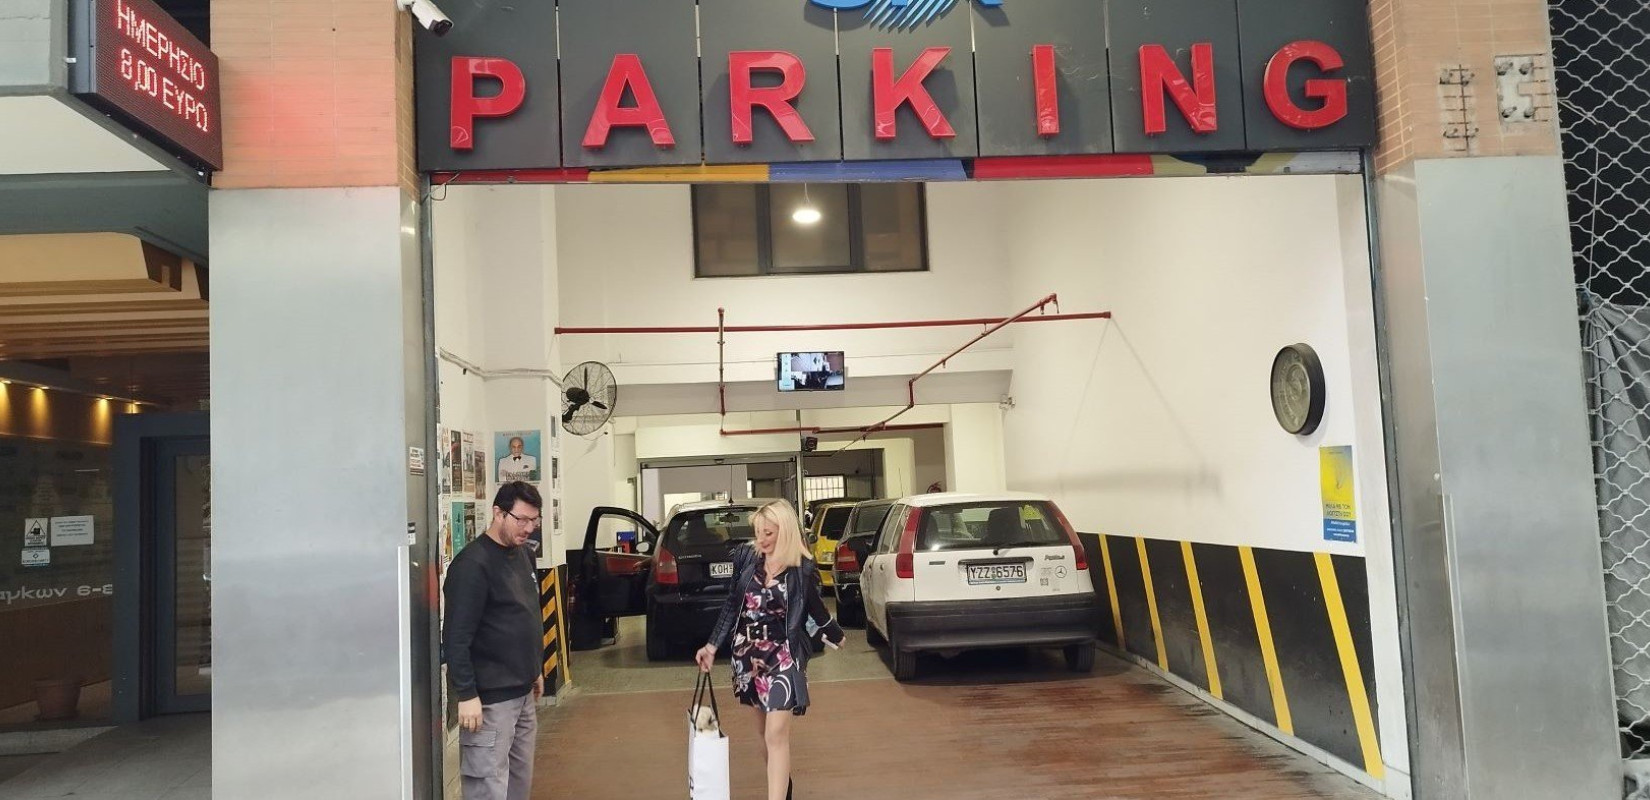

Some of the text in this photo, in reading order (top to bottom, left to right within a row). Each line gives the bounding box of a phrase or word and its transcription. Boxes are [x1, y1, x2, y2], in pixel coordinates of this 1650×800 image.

[121, 48, 208, 132] 8,00 ΕΥΡΩ
[450, 40, 1349, 150] PARKING
